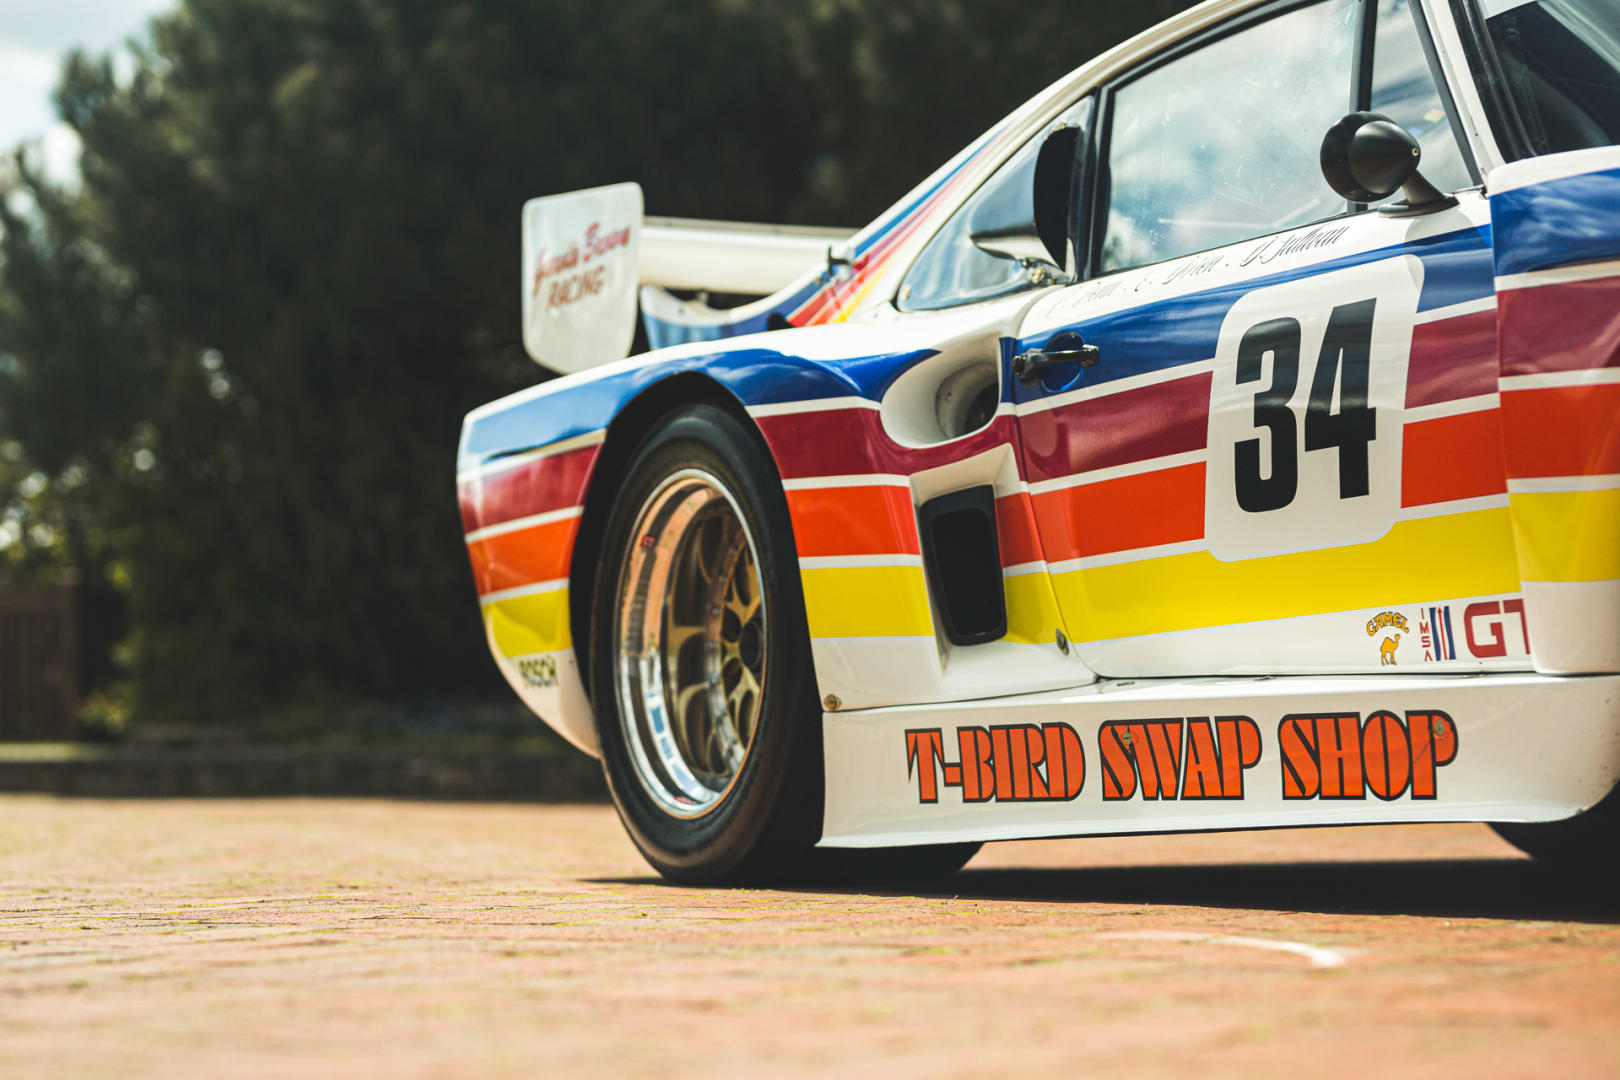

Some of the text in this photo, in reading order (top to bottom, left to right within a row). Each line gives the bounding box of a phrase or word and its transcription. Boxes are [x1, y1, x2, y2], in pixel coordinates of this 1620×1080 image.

[546, 264, 605, 307] RACING
[1234, 297, 1377, 513] 34
[1366, 611, 1410, 637] CAMEL
[904, 710, 1459, 804] T-BIRD SWAP SHOP
